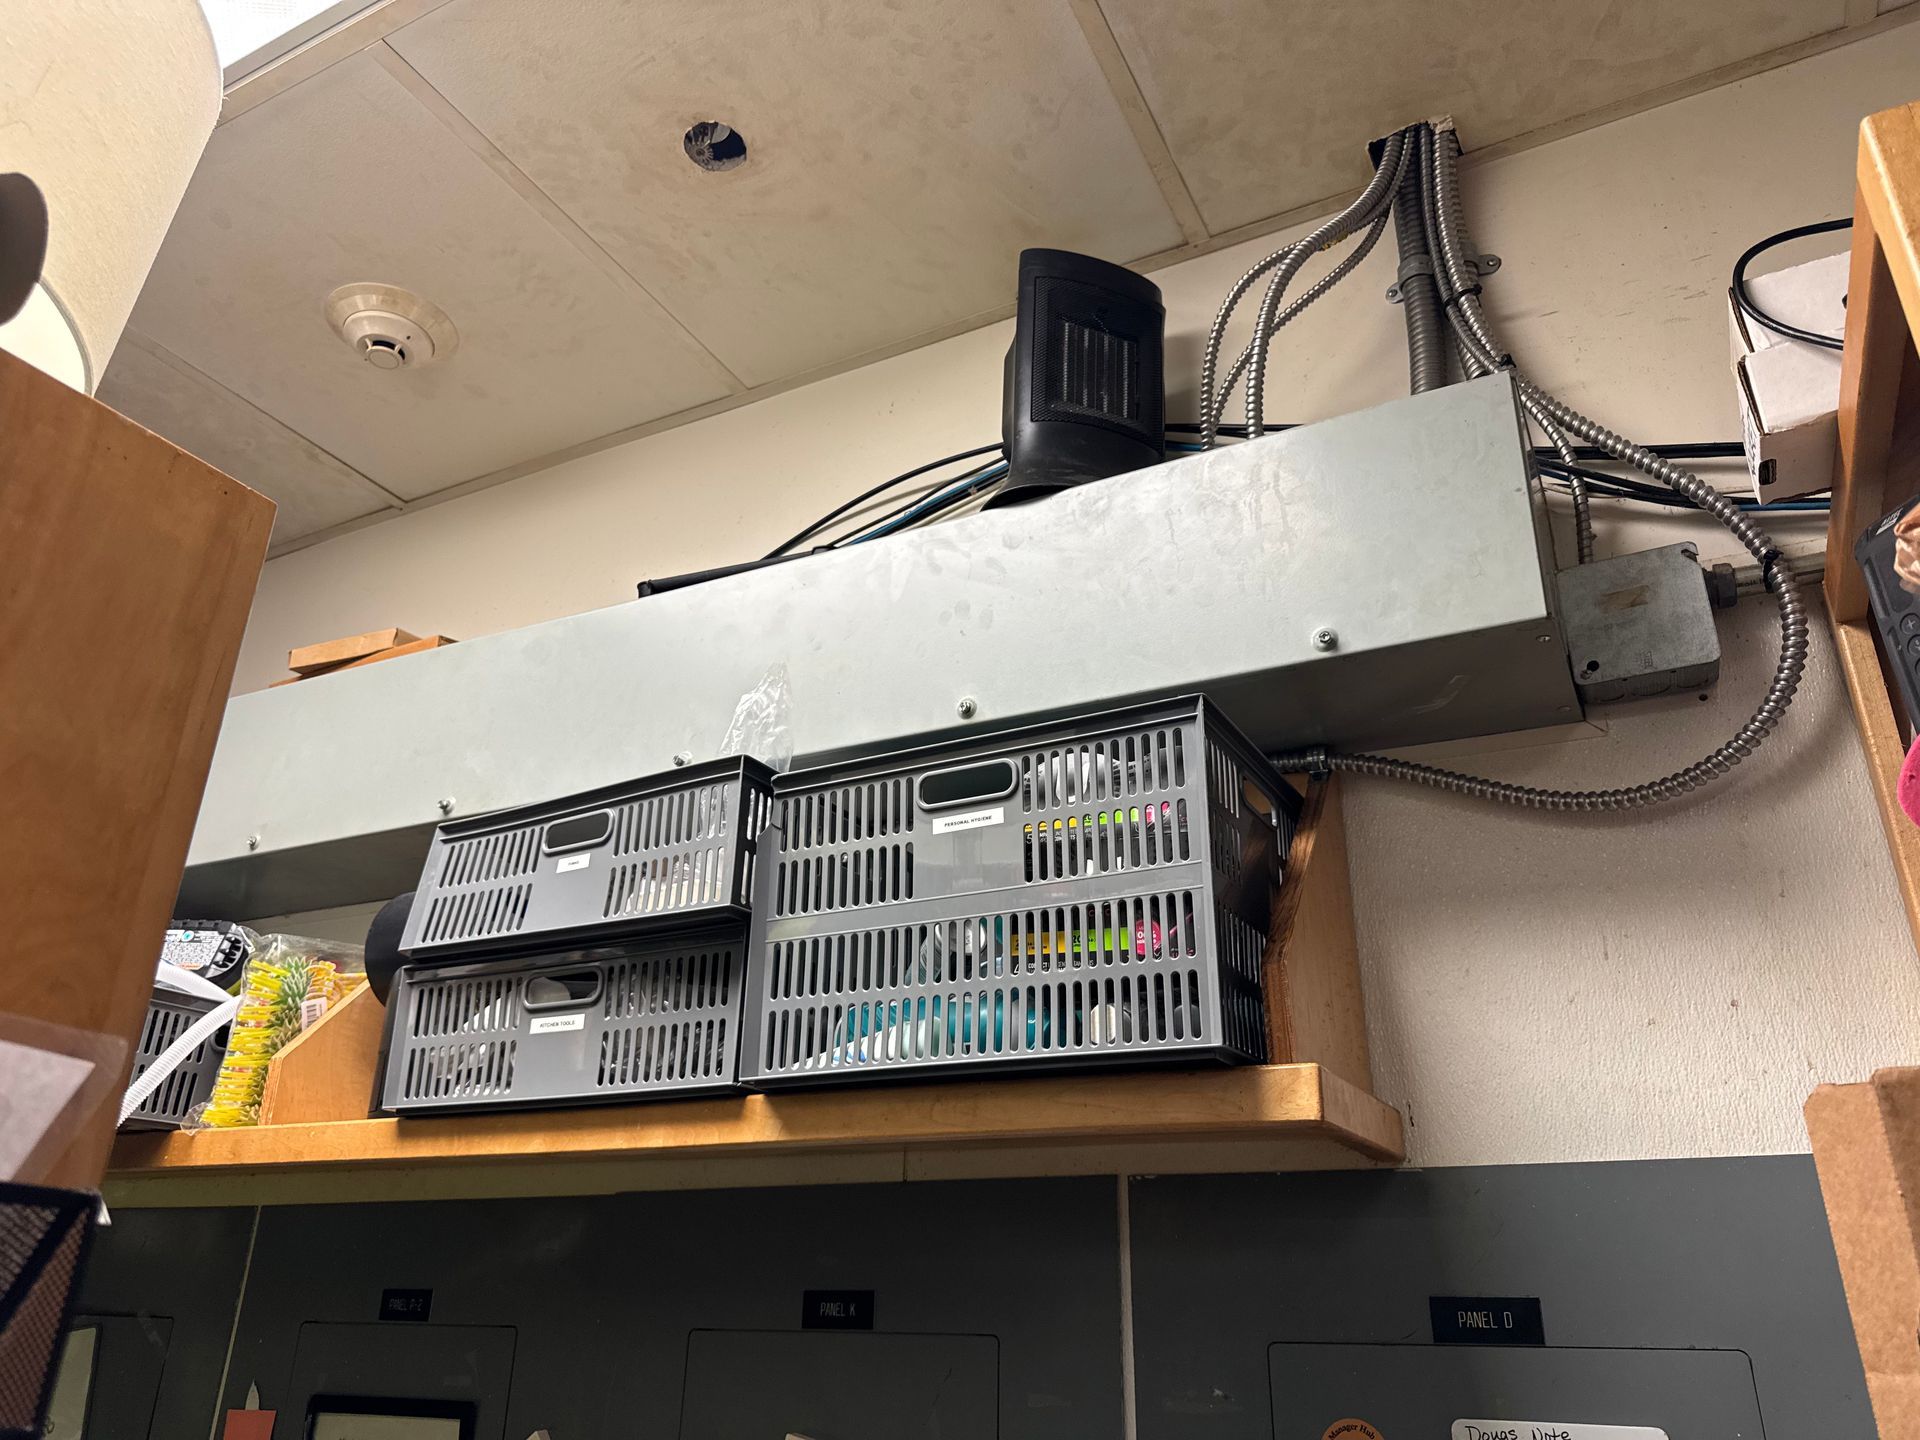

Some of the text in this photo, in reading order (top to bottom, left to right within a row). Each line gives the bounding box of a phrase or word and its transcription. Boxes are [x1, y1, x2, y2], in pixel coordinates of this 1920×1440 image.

[944, 815, 992, 828] PERSONAL HYGIENE
[820, 1302, 846, 1317] PANEL
[1458, 1311, 1513, 1329] PANEL D
[1328, 1424, 1375, 1440] Manager Hub
[1532, 1427, 1571, 1440] Note
